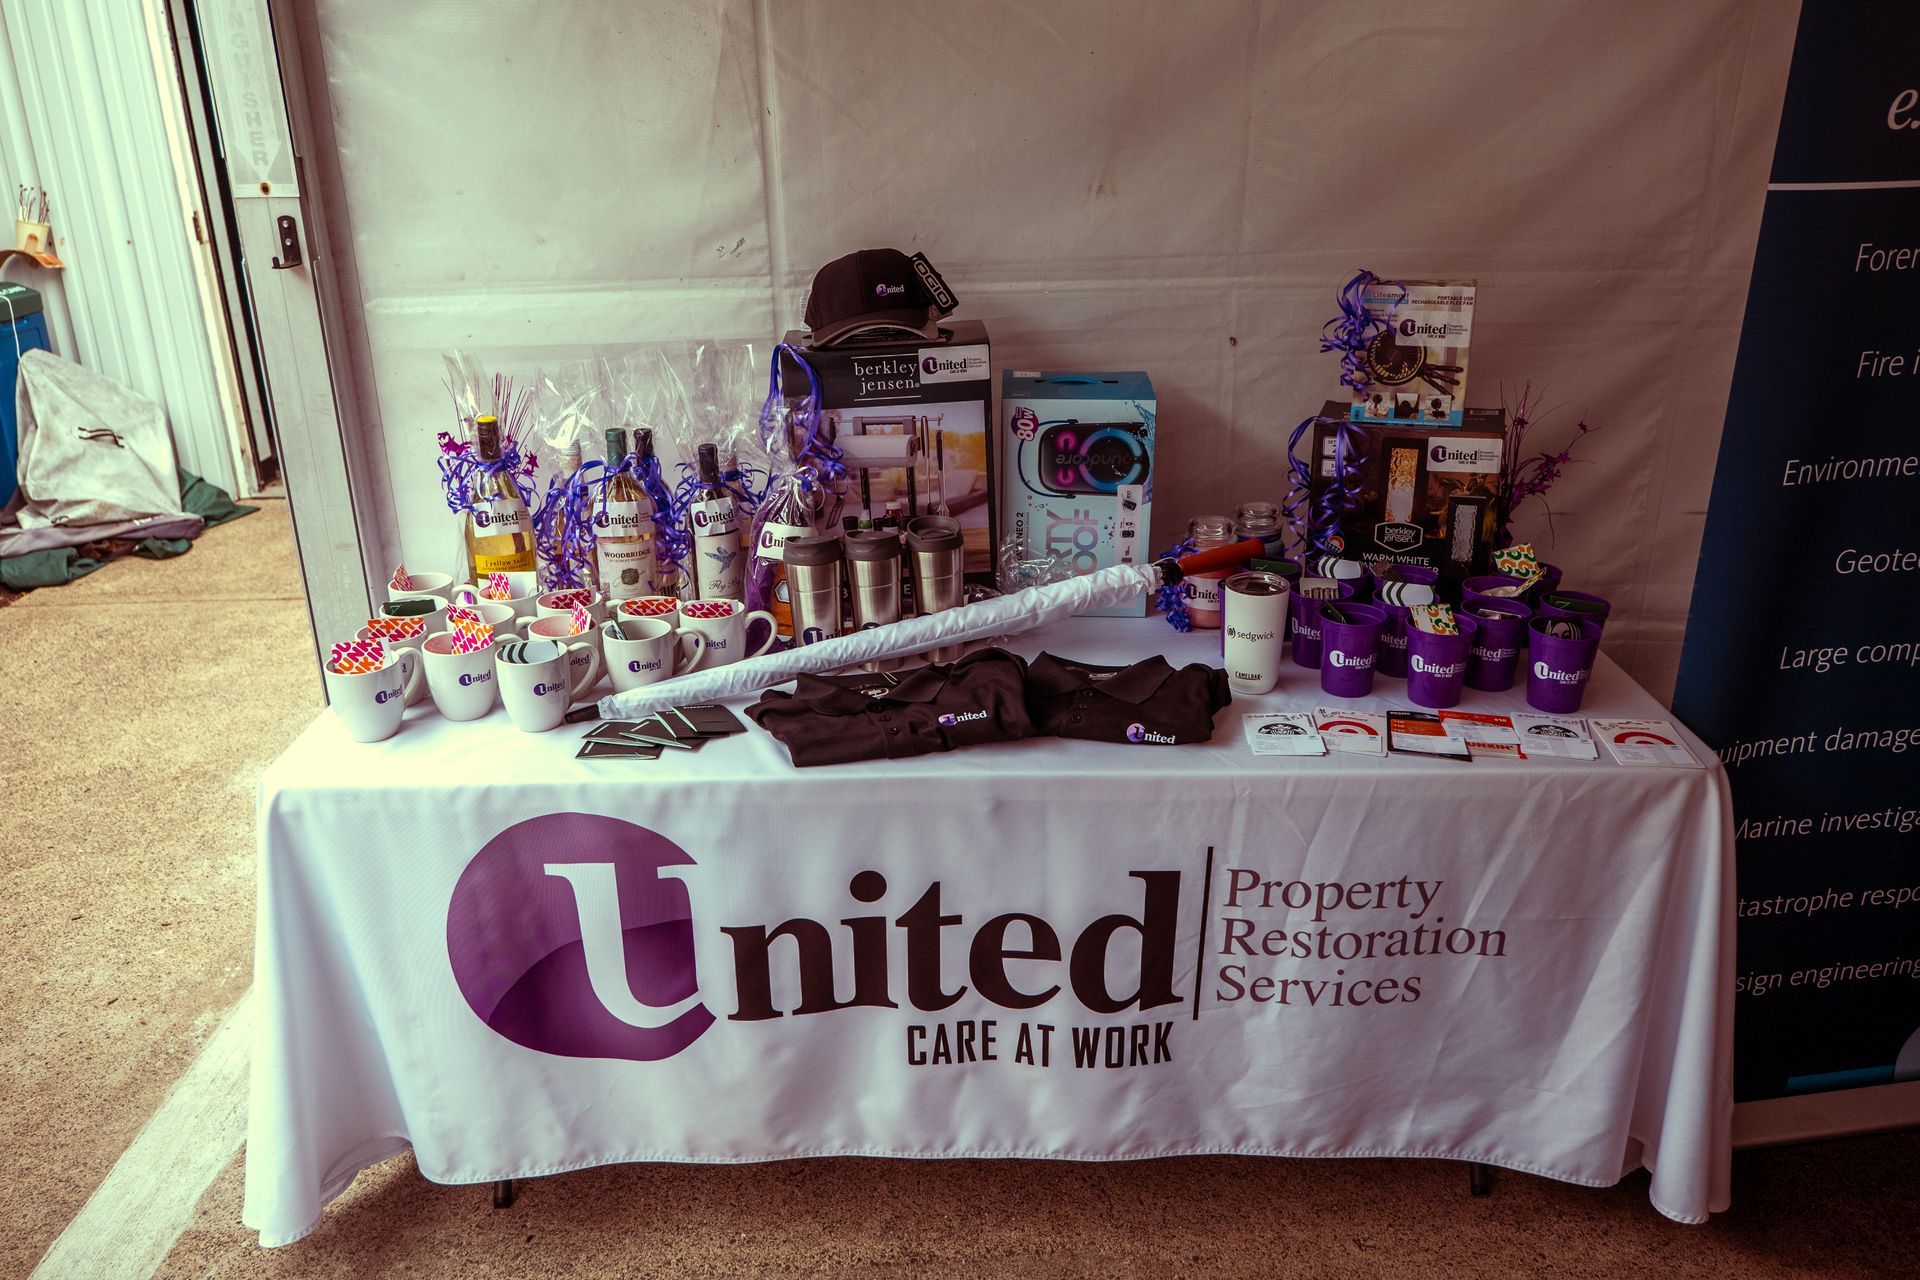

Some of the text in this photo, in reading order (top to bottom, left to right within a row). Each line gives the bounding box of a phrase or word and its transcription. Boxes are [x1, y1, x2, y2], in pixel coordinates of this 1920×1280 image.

[913, 260, 952, 308] OGIO
[1399, 318, 1447, 337] United
[853, 360, 917, 377] berkley
[921, 356, 967, 375] United
[1856, 350, 1904, 379] Fire
[1016, 406, 1035, 442] 80W
[1430, 445, 1478, 463] United
[475, 510, 519, 528] United
[694, 509, 735, 528] United
[761, 530, 785, 549] Uni
[1384, 526, 1416, 539] berkley
[604, 548, 651, 560] WOODBRIDGE
[1363, 552, 1394, 564] WARM
[1396, 556, 1430, 566] WHITE
[1237, 630, 1275, 642] sedgwick
[1381, 632, 1408, 650] nited
[570, 654, 590, 665] nited
[628, 659, 662, 674] United
[1329, 650, 1373, 668] United
[1411, 654, 1455, 675] United
[1779, 645, 1849, 673] Large
[458, 669, 492, 687] United
[1533, 661, 1580, 681] United
[533, 678, 566, 697] United
[938, 709, 988, 726] United
[1126, 722, 1176, 745] United
[1223, 868, 1444, 922] Property
[446, 812, 1185, 1062] United
[1217, 916, 1507, 960] Restoration
[1216, 965, 1422, 1007] Services
[907, 1020, 1175, 1069] CARE AT WORK
